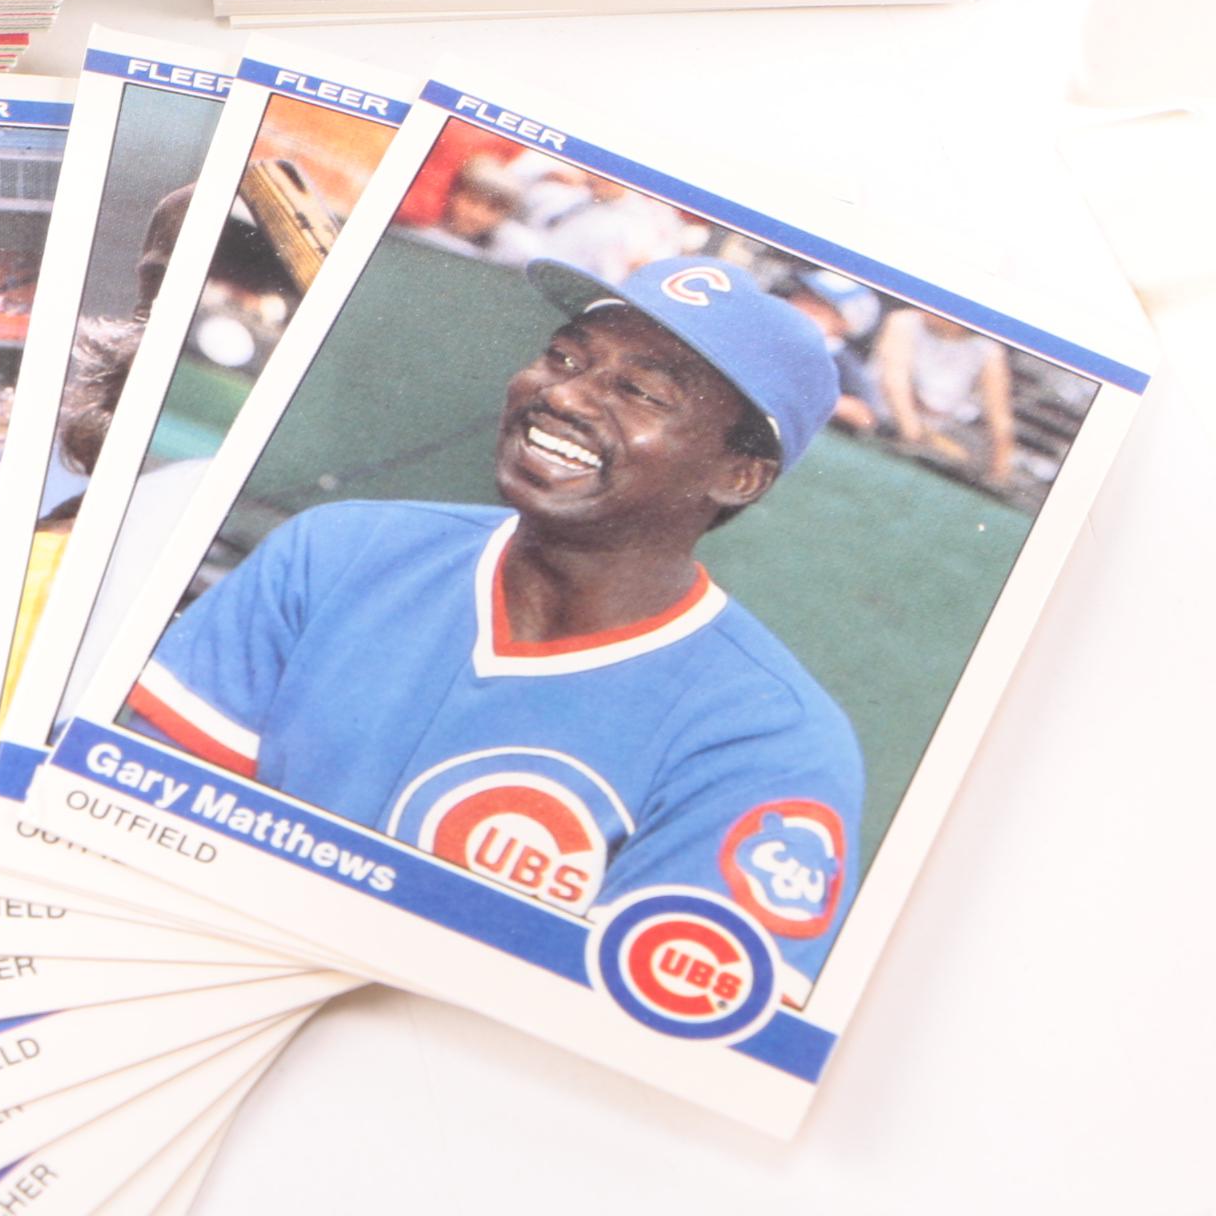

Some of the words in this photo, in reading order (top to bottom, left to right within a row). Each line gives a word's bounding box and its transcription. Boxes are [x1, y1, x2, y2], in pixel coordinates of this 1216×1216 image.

[275, 69, 390, 117] FLEER
[455, 96, 569, 151] FLEER
[66, 790, 218, 865] OUTFIELD
[85, 743, 190, 809] Gary
[192, 784, 398, 892] Matthews
